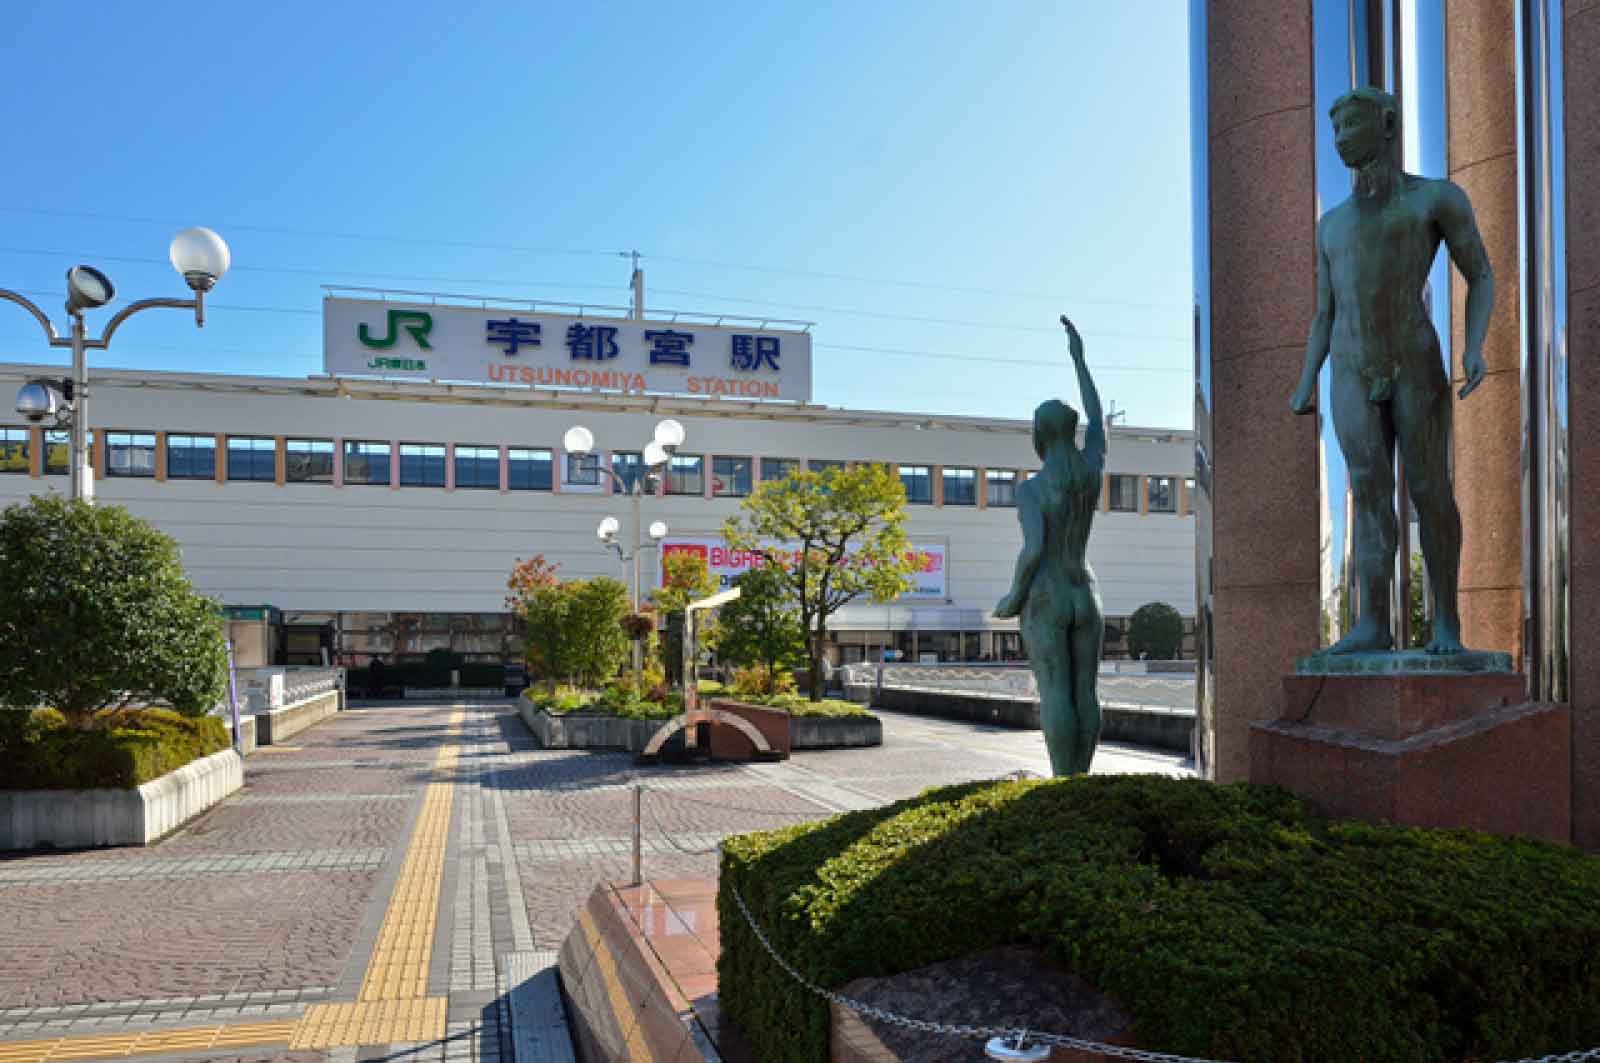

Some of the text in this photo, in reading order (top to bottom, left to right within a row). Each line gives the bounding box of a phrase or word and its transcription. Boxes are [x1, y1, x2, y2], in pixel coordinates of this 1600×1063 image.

[359, 309, 433, 349] JR
[486, 317, 780, 371] 宇都宮駅
[488, 363, 779, 397] UTSUNOMIYA STATION
